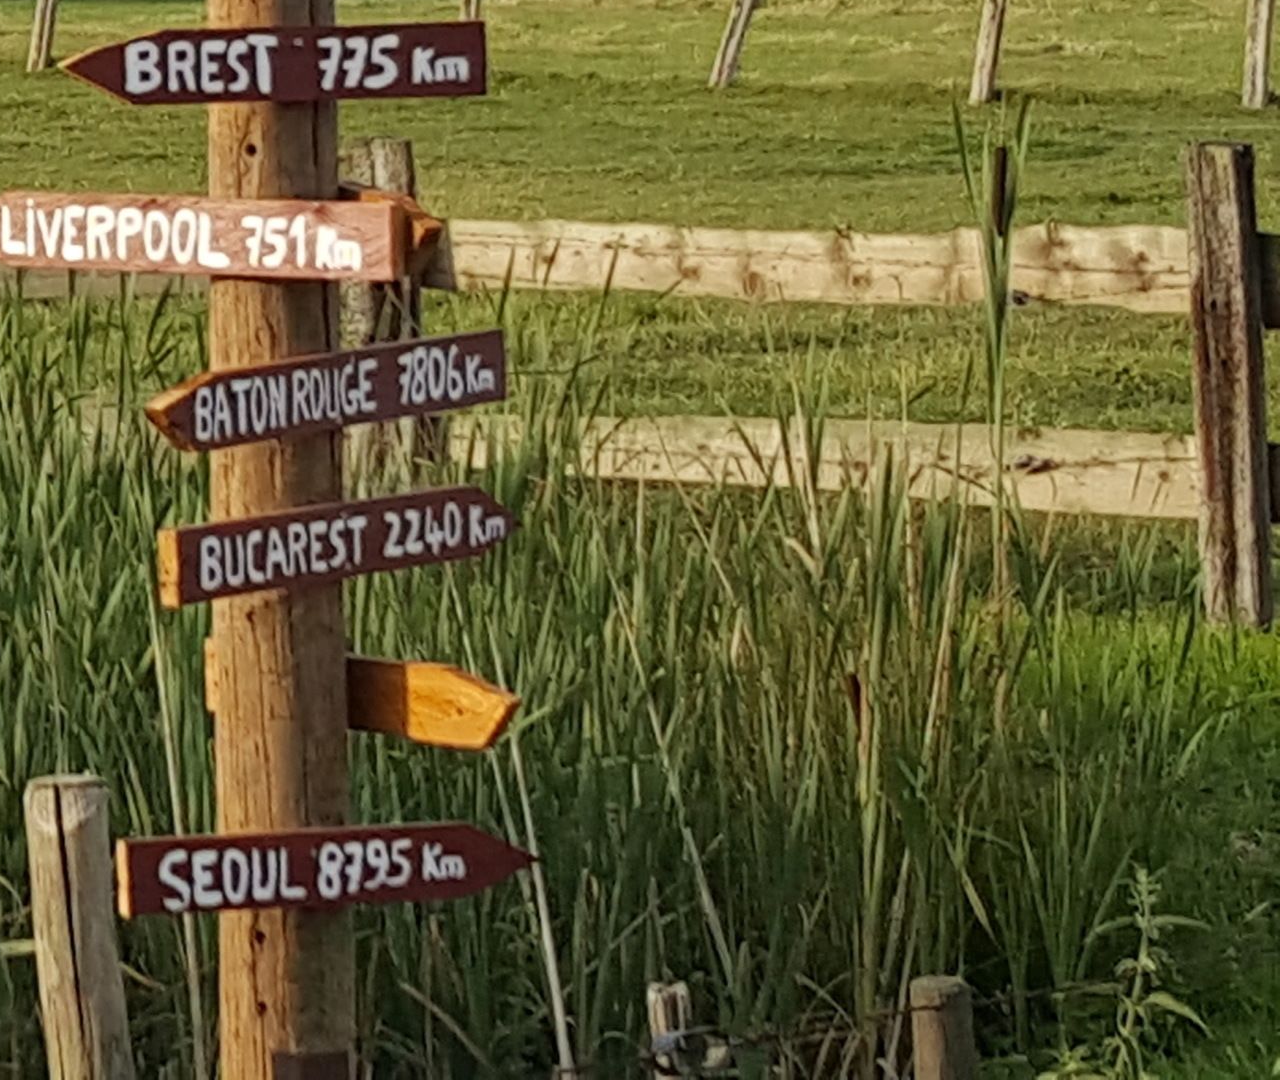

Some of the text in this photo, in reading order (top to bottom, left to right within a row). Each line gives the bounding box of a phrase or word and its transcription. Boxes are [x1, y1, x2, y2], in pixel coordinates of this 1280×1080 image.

[124, 34, 470, 95] BREST 775 Km
[241, 213, 307, 269] 751
[195, 374, 287, 442] BATON
[292, 356, 378, 424] ROUGE
[397, 344, 464, 406] 7806
[199, 501, 506, 592] BUCAREST 2240 Km
[158, 838, 466, 912] SEOUL 8795 Km
